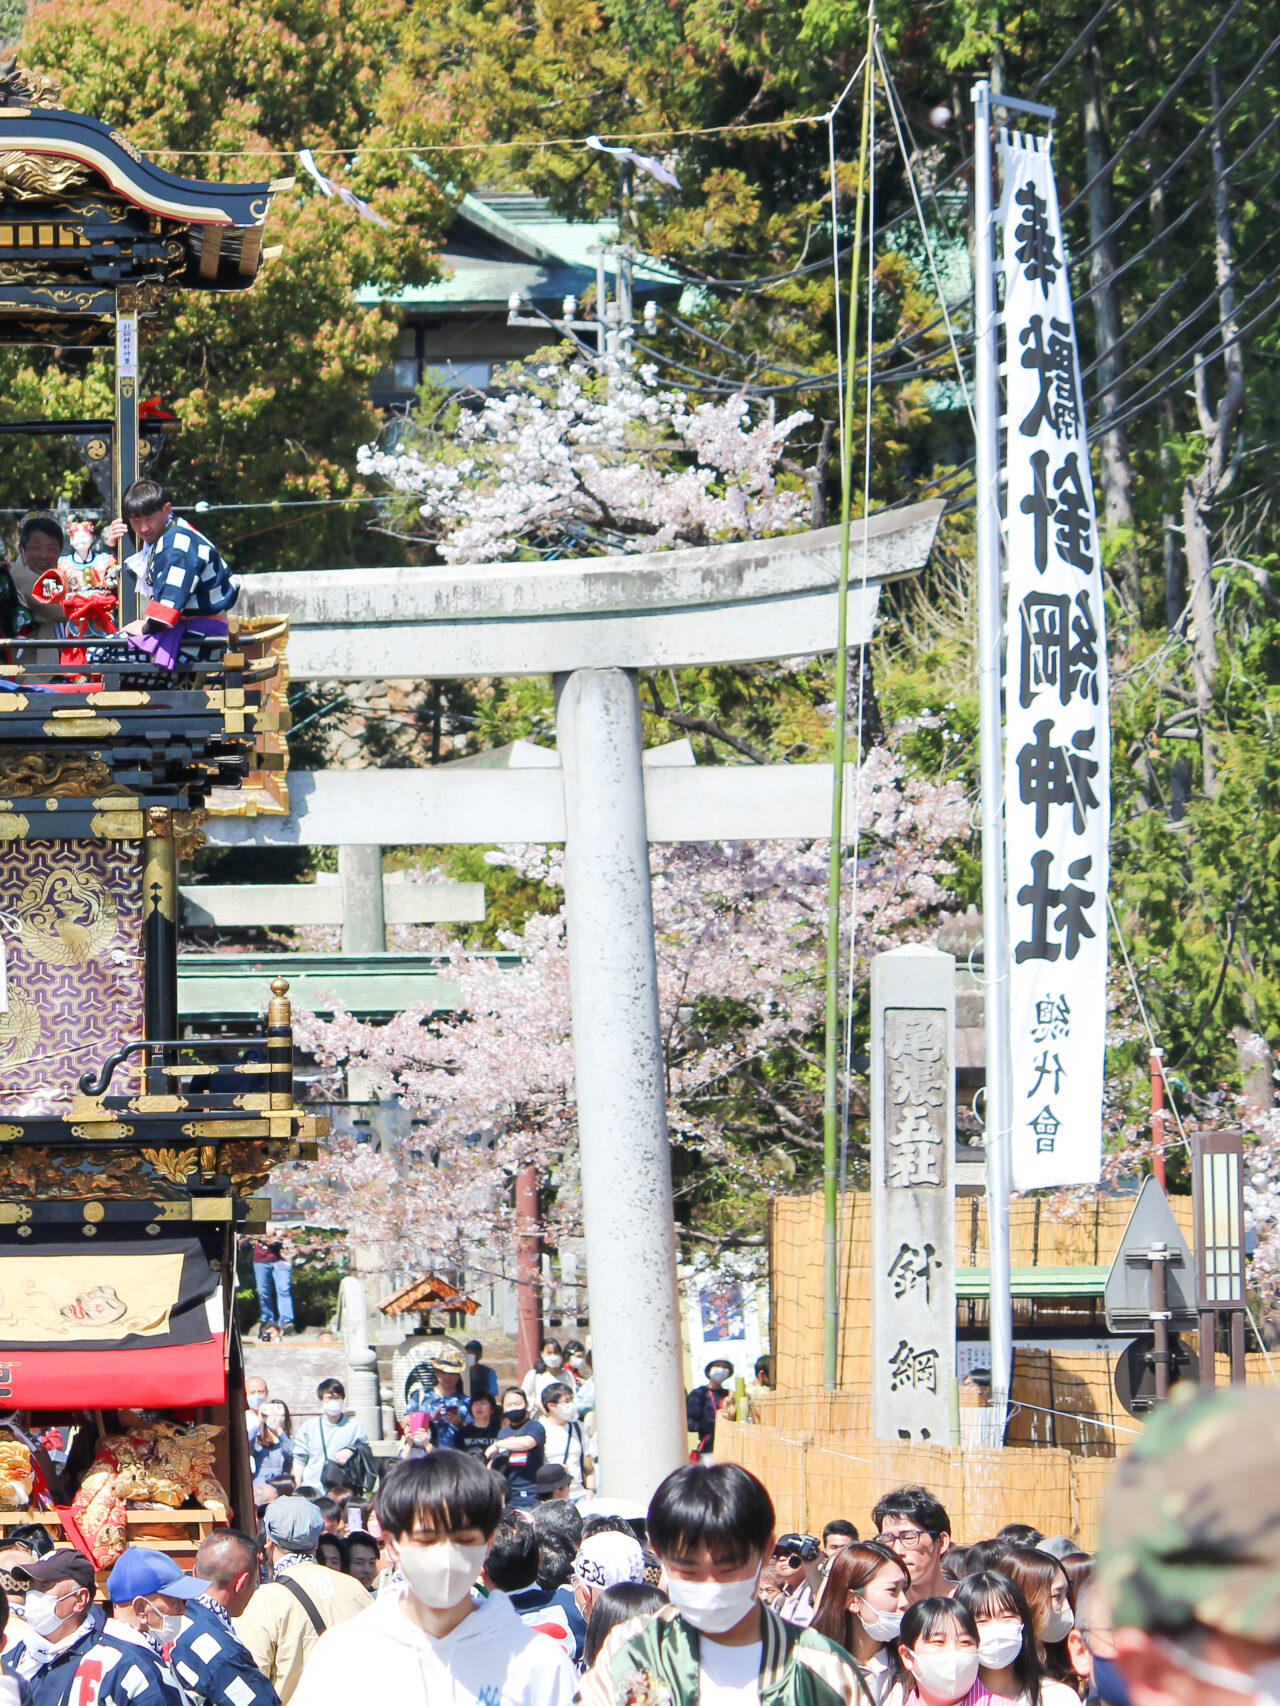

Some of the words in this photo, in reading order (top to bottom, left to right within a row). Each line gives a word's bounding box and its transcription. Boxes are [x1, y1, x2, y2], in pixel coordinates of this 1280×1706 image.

[888, 1018, 944, 1187] 尾張五社
[886, 1243, 943, 1441] 針綱
